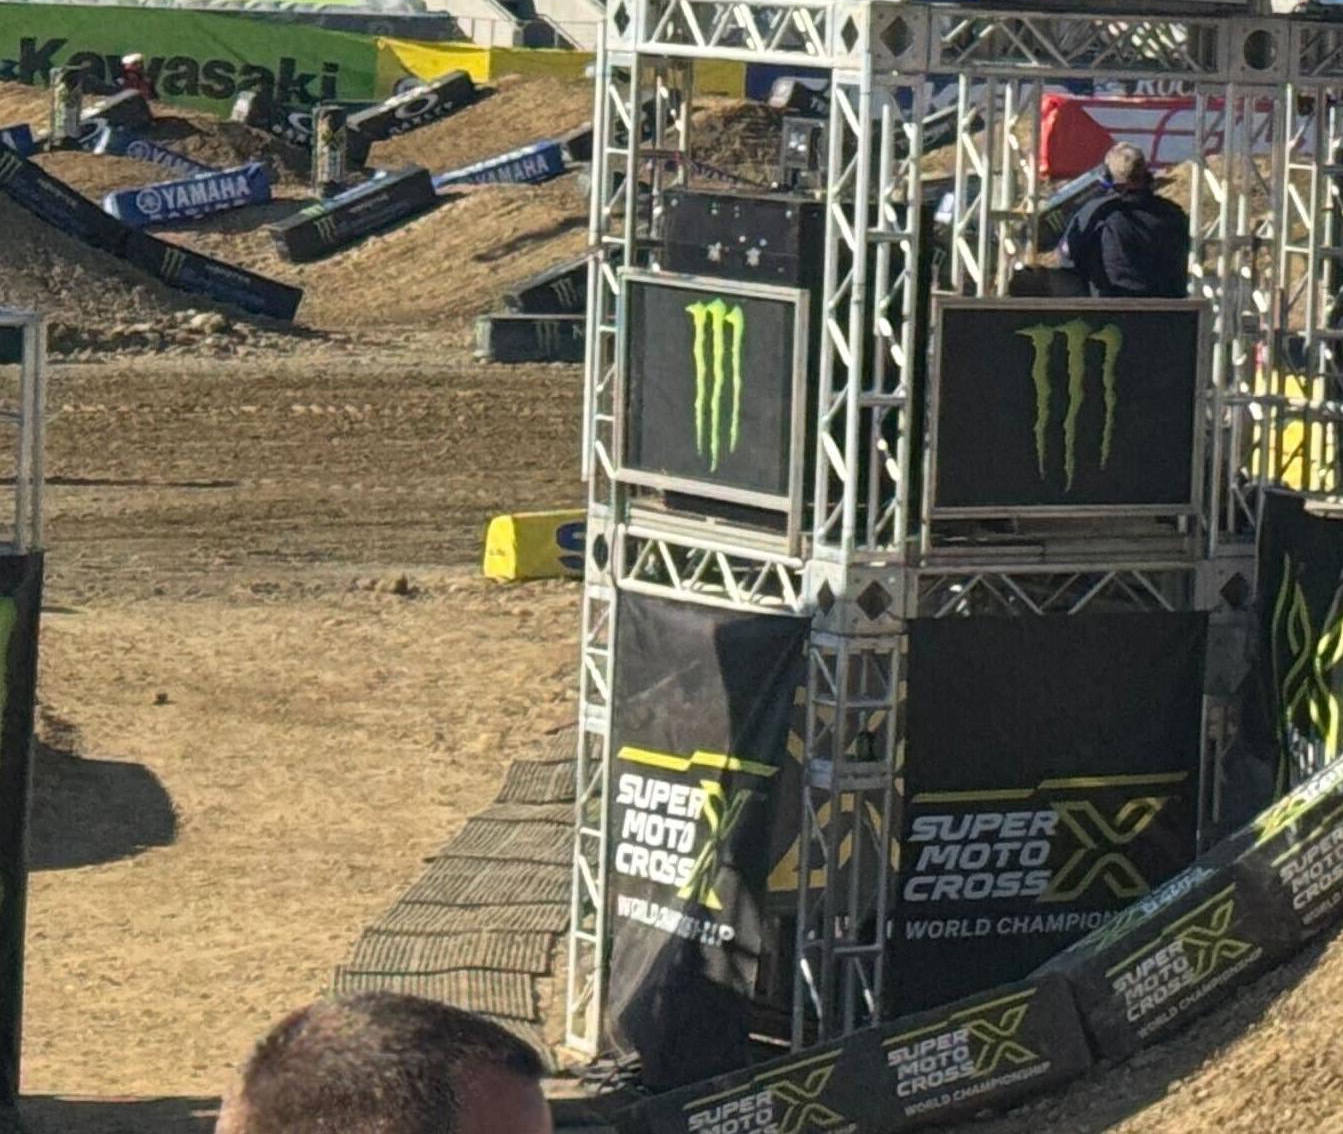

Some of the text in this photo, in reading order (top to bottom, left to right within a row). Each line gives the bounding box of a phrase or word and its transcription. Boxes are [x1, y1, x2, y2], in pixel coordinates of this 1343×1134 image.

[160, 174, 251, 210] YAMAHA
[616, 774, 705, 818] SUPER
[621, 809, 697, 854] MOTO
[908, 809, 1059, 843] SUPER
[615, 843, 699, 887] CROSS
[915, 841, 1052, 872] MOTO
[903, 870, 1053, 904] CROSS
[905, 917, 991, 940] WORLD
[1112, 939, 1186, 995] SUPER
[1124, 954, 1189, 1002] MOTO
[1125, 972, 1195, 1023] CROSS
[887, 1022, 971, 1065] SUPER
[897, 1043, 971, 1080] MOTO
[895, 1063, 976, 1098] CROSS
[904, 1060, 1052, 1118] WORLD CHAMPIONSHIP
[687, 1089, 774, 1133] SUPER
